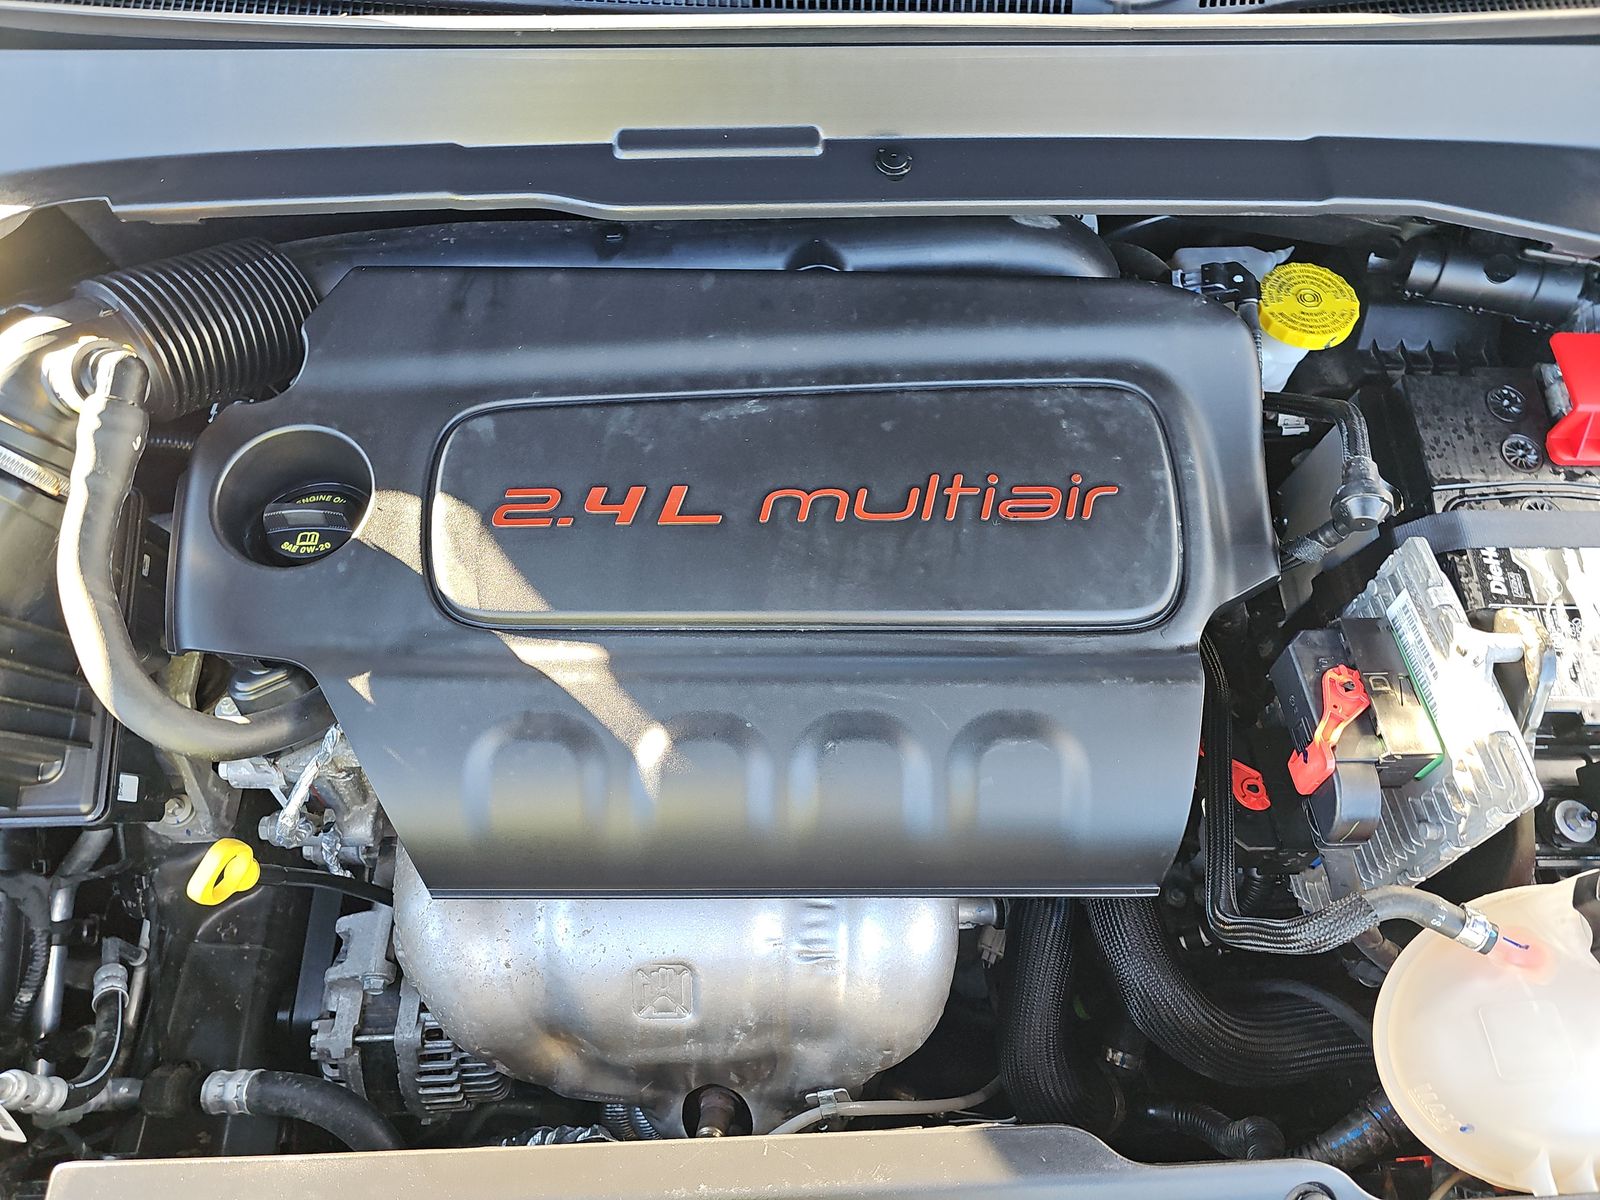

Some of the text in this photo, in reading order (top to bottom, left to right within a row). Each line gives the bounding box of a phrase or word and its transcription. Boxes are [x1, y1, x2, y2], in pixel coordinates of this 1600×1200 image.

[296, 494, 332, 504] ENGINE
[759, 473, 1119, 523] multiair
[280, 541, 331, 554] SAE 0W-20
[1481, 547, 1508, 596] DieH
